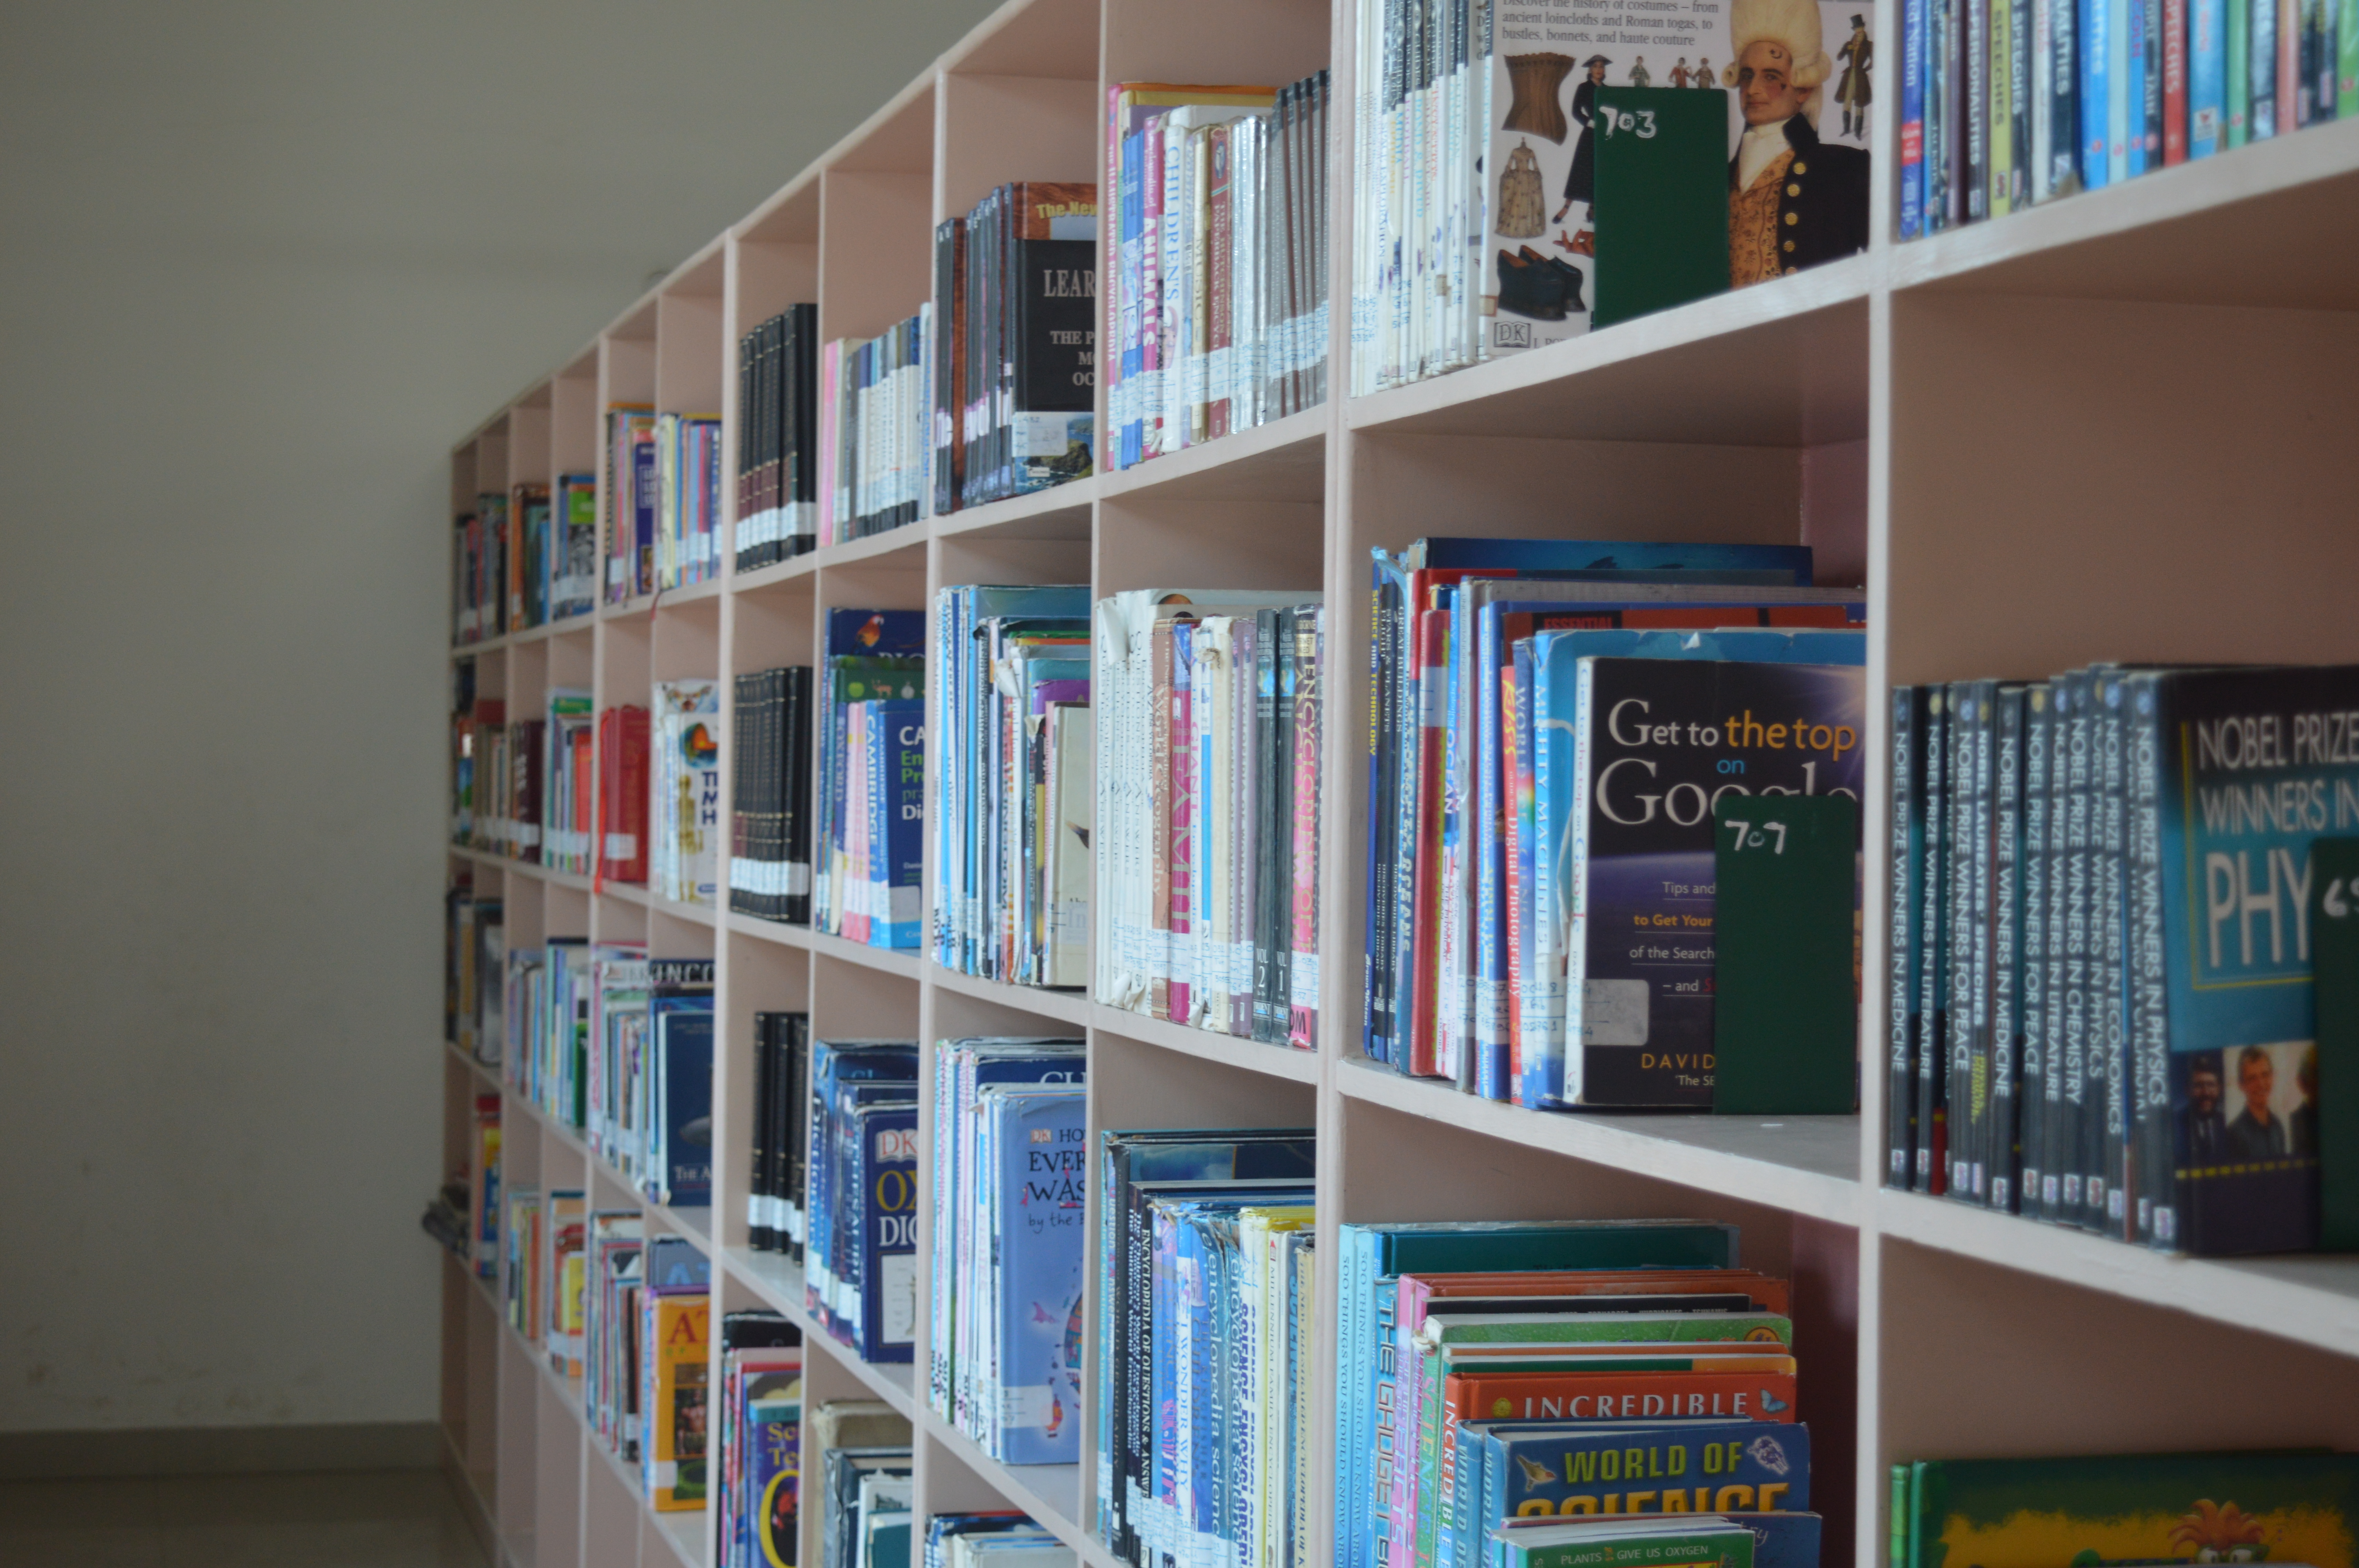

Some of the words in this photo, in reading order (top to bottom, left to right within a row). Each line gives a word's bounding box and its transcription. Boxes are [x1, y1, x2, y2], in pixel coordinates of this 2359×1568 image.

[1503, 13, 1541, 23] ancient
[1545, 13, 1599, 25] loincloths
[1602, 15, 1622, 27] and
[1626, 16, 1663, 28] Roman
[1668, 18, 1698, 32] togas,
[1702, 18, 1712, 29] to
[1627, 1, 1678, 11] costumes
[1692, 2, 1718, 13] from
[1502, 28, 1543, 42] bustles,
[1547, 29, 1592, 44] bonnets,
[1596, 32, 1616, 43] and
[1620, 31, 1648, 44] haute
[1653, 34, 1694, 46] couture
[2012, 12, 2023, 114] SPEECHES
[1969, 13, 1981, 165] PERSONALITIES
[1994, 9, 2003, 126] SPEECHES
[1599, 106, 1656, 140] 703
[1165, 146, 1181, 300] CHILDREN'S
[1143, 218, 1156, 347] ANIMALS
[1050, 331, 1081, 344] THE
[1499, 324, 1525, 343] DK
[1580, 668, 1588, 706] Get
[1155, 685, 1166, 756] World
[1515, 687, 1527, 778] WORLD
[1534, 686, 1549, 789] MIGHTY
[1580, 717, 1585, 735] to
[1609, 699, 1681, 745] Get
[1688, 722, 1719, 746] to
[1725, 710, 1787, 749] the
[1793, 719, 1856, 761] top
[2198, 716, 2286, 771] NOBEL
[2294, 712, 2359, 764] PRIZE
[1191, 722, 1199, 817] GIANT
[1303, 664, 1315, 875] ENCYCLOPEDIA
[1444, 729, 1455, 813] OCEAN
[1717, 759, 1745, 774] on
[1957, 733, 1971, 797] NOBEL
[2000, 738, 2014, 804] NOBEL
[2070, 719, 2085, 787] NOBEL
[2106, 719, 2119, 790] NOBEL
[2137, 726, 2155, 800] NOBEL
[1575, 778, 1584, 808] top
[2069, 794, 2085, 845] PRIZE
[2200, 779, 2326, 836] WINNERS
[1153, 763, 1165, 897] Geography
[1506, 817, 1519, 876] Digital
[1725, 820, 1786, 854] 707
[1957, 804, 1970, 853] PRIZE
[1999, 811, 2013, 861] PRIZE
[2106, 798, 2119, 850] PRIZE
[2139, 808, 2157, 862] PRIZE
[1536, 802, 1549, 943] MACHINES
[1663, 882, 1689, 896] Tips
[1692, 882, 1716, 895] and
[1301, 889, 1312, 927] OF
[1634, 915, 1648, 926] to
[1653, 915, 1677, 926] Get
[1682, 915, 1713, 927] Your
[1956, 861, 1970, 955] WINNERS
[1997, 868, 2012, 963] WINNERS
[2068, 854, 2084, 953] WINNERS
[2106, 858, 2119, 960] WINNERS
[2141, 871, 2162, 978] WINNERS
[1256, 948, 1268, 963] VOL
[1277, 951, 1287, 967] VOL
[1508, 884, 1521, 998] Photography
[1629, 947, 1643, 958] of
[1648, 947, 1669, 958] the
[1673, 947, 1716, 959] Search
[1259, 967, 1265, 987] 2
[1279, 971, 1283, 991] 1
[1676, 980, 1699, 992] and
[1955, 962, 1969, 1000] FOR
[1997, 971, 2011, 993] IN
[2067, 961, 2083, 982] IN
[2107, 968, 2121, 991] IN
[2146, 984, 2162, 1009] IN
[1642, 1053, 1715, 1069] DAVID
[1955, 1008, 1969, 1069] PEACE
[1995, 999, 2011, 1096] MEDICINE
[2065, 990, 2083, 1103] CHEMISTRY
[2108, 998, 2121, 1134] ECONOMICS
[2146, 1017, 2166, 1105] PHYSICS
[882, 1131, 917, 1155] DK
[1032, 1130, 1051, 1142] DK
[1029, 1213, 1043, 1234] by
[1050, 1211, 1072, 1226] the
[1141, 1229, 1150, 1329] ENCYCLOPEDIA
[1142, 1335, 1150, 1351] OF
[1208, 1255, 1223, 1437] encyclopedia
[1379, 1299, 1395, 1376] THE
[1525, 1393, 1747, 1418] INCREDIBLE
[1211, 1447, 1223, 1536] scienc
[1390, 1424, 1407, 1547] FACTS
[1440, 1399, 1455, 1549] INCREDIBLE
[1456, 1445, 1468, 1530] WORLD
[1565, 1445, 1686, 1484] WORLD
[1704, 1442, 1743, 1474] OF
[1561, 1553, 1602, 1564] PLANTS
[1617, 1549, 1641, 1560] GIVE
[1647, 1548, 1660, 1558] US
[1667, 1546, 1708, 1557] OXYGEN
